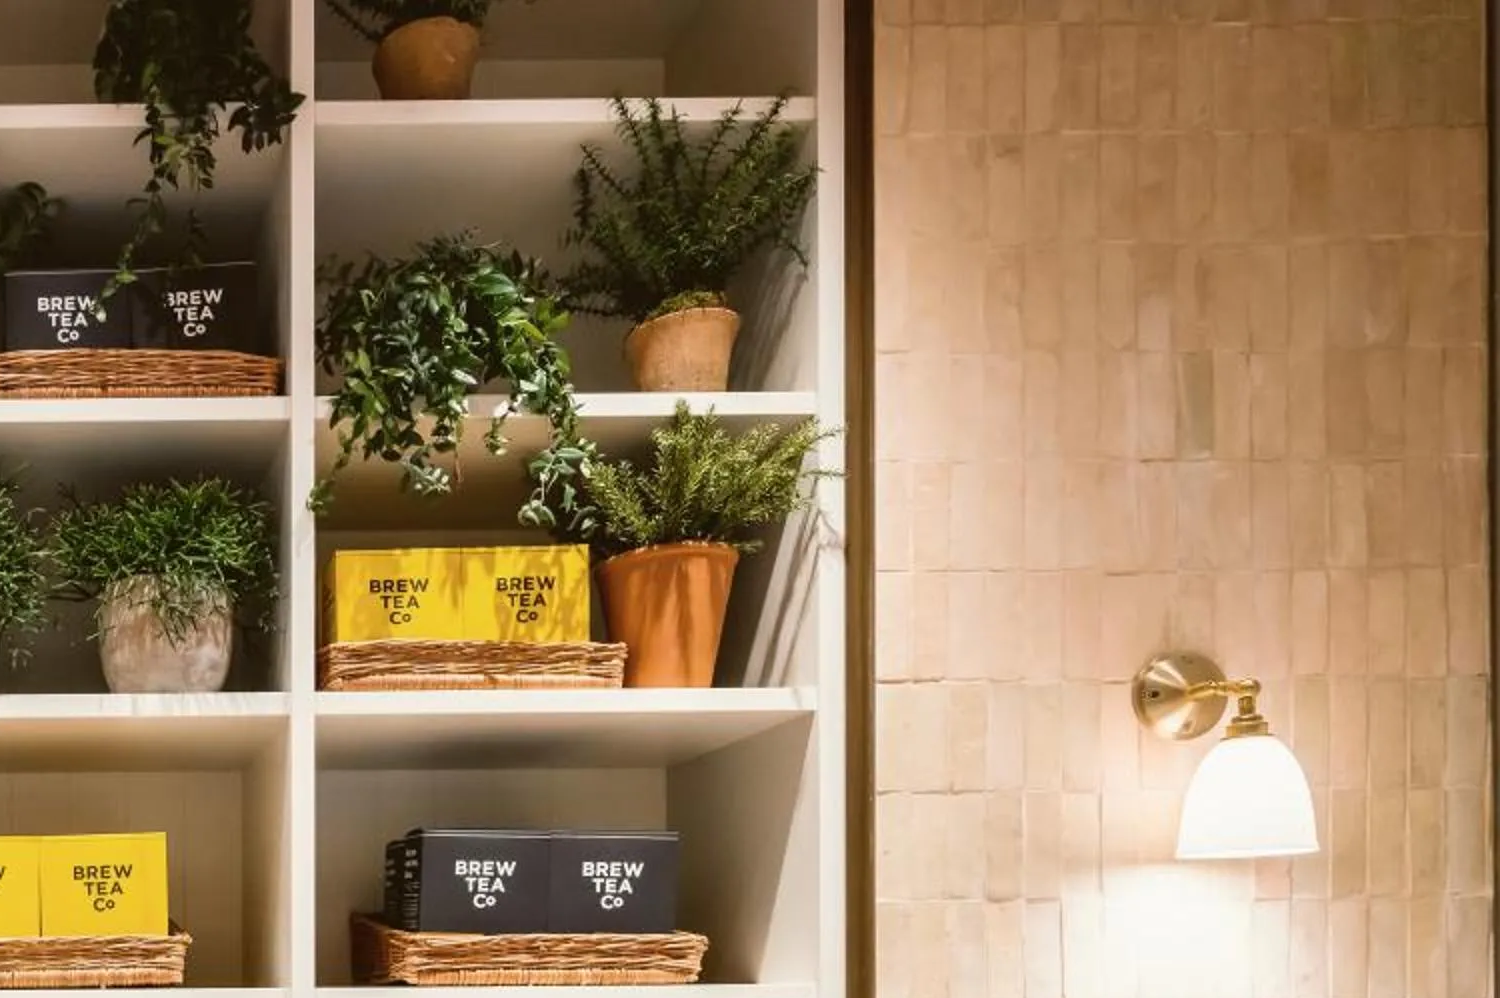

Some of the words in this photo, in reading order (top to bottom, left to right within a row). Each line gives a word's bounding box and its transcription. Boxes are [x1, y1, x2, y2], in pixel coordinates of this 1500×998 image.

[37, 296, 97, 312] BREW
[48, 312, 88, 327] TEA
[173, 305, 214, 322] TEA
[369, 578, 429, 593] BREW
[496, 576, 556, 592] BREW
[380, 594, 420, 609] TEA
[507, 592, 547, 608] TEA
[389, 611, 412, 625] Co
[516, 609, 539, 623] Co
[73, 864, 133, 880] BREW
[455, 861, 517, 877] BREW
[582, 862, 645, 878] BREW
[84, 881, 124, 896] TEA
[465, 877, 505, 893] TEA
[592, 878, 633, 894] TEA
[93, 897, 115, 912] Co
[473, 894, 497, 908] Co
[600, 895, 624, 909] Co
